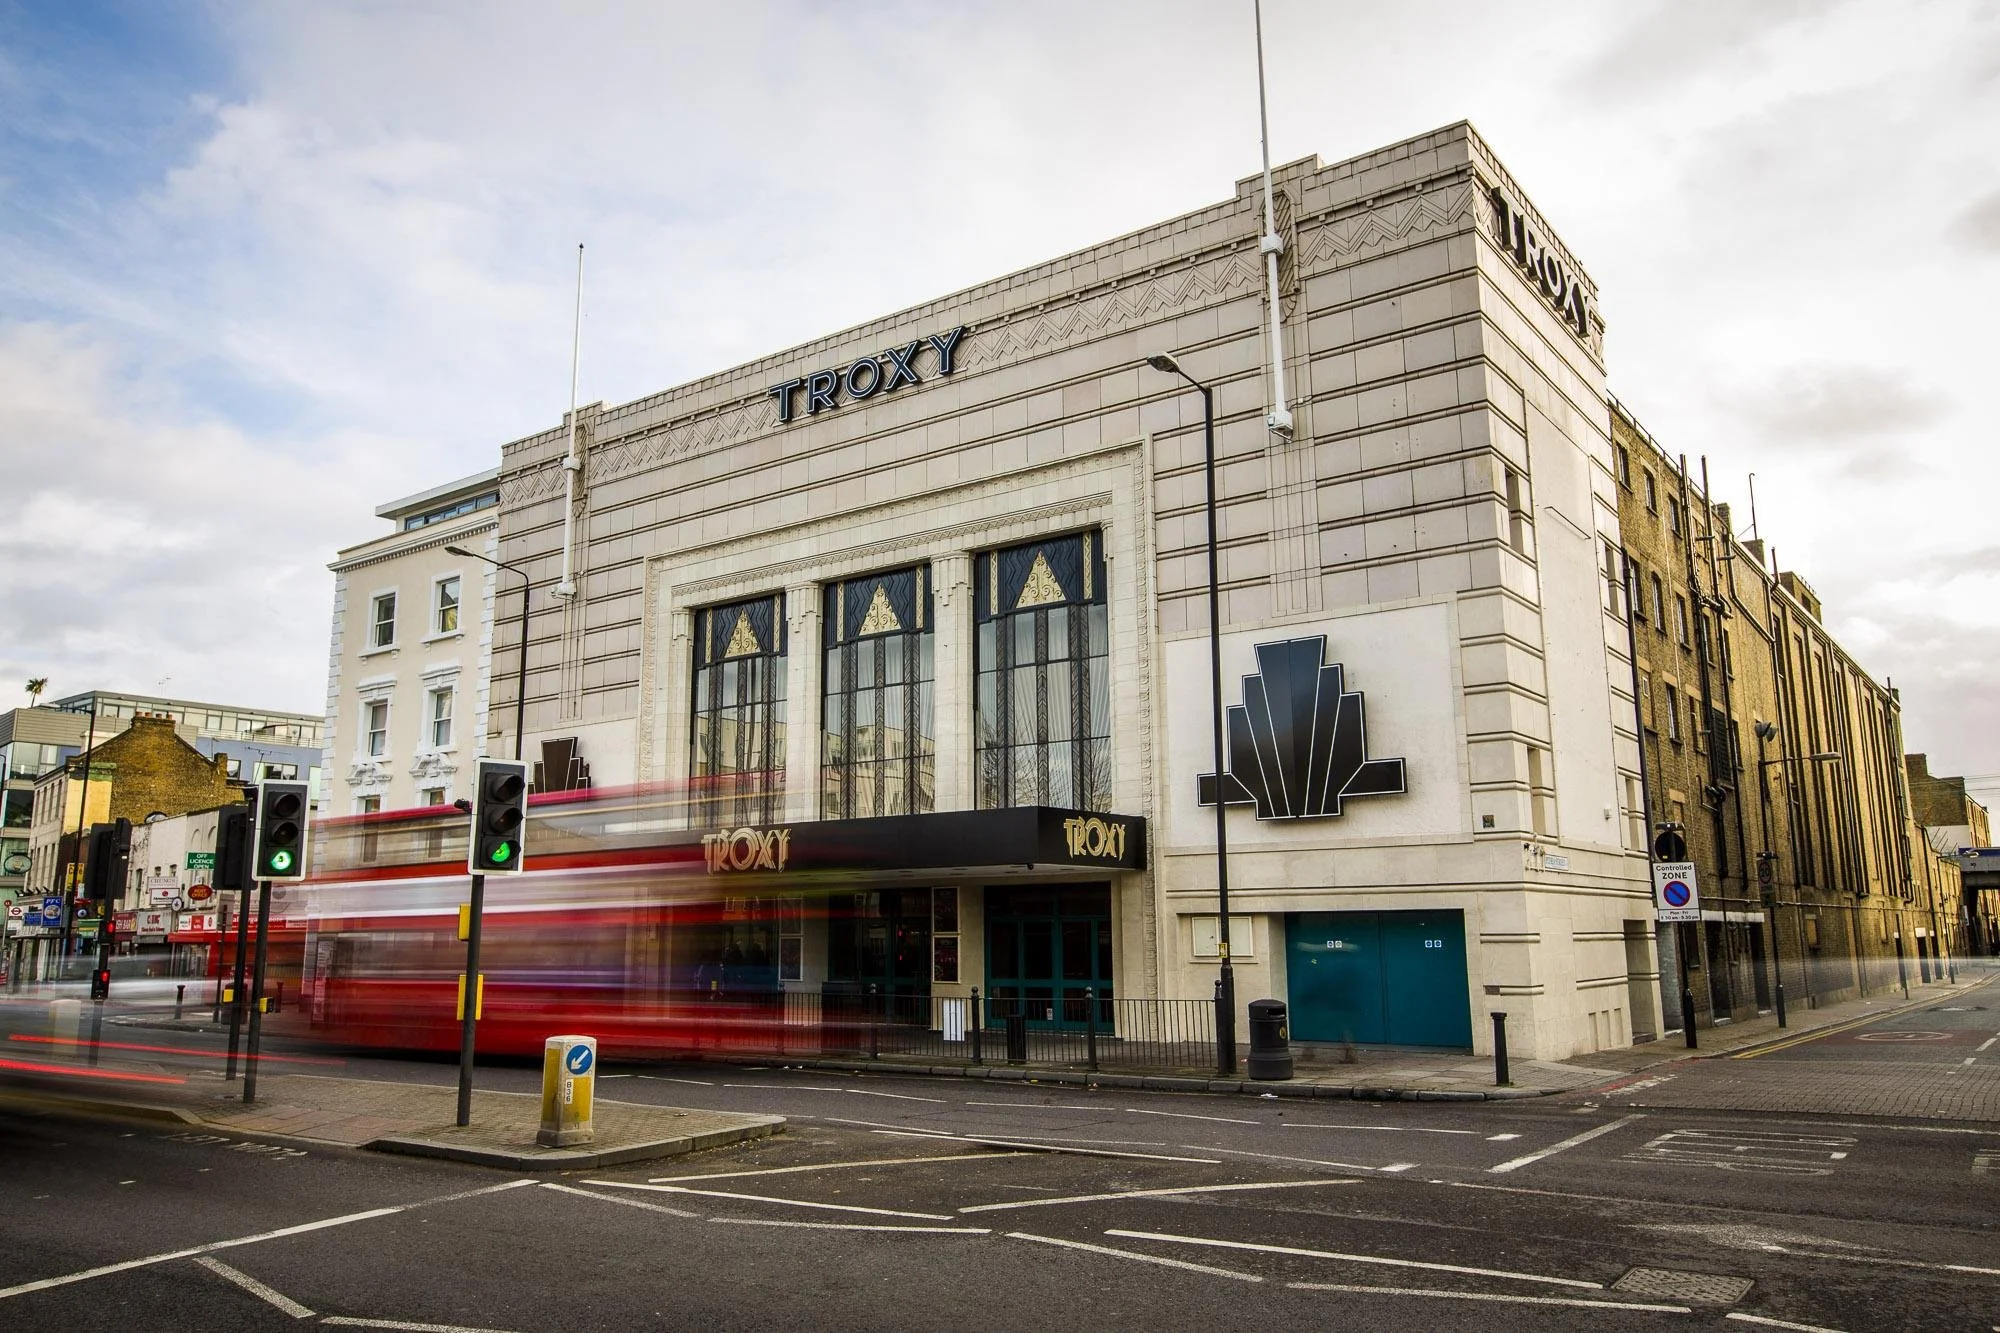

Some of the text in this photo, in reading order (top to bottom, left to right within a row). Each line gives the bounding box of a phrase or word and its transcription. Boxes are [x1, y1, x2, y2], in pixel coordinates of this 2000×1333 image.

[1491, 186, 1590, 339] TROXY
[769, 326, 964, 422] TROXY
[701, 827, 791, 875] TROXY
[1063, 816, 1126, 861] TROXY
